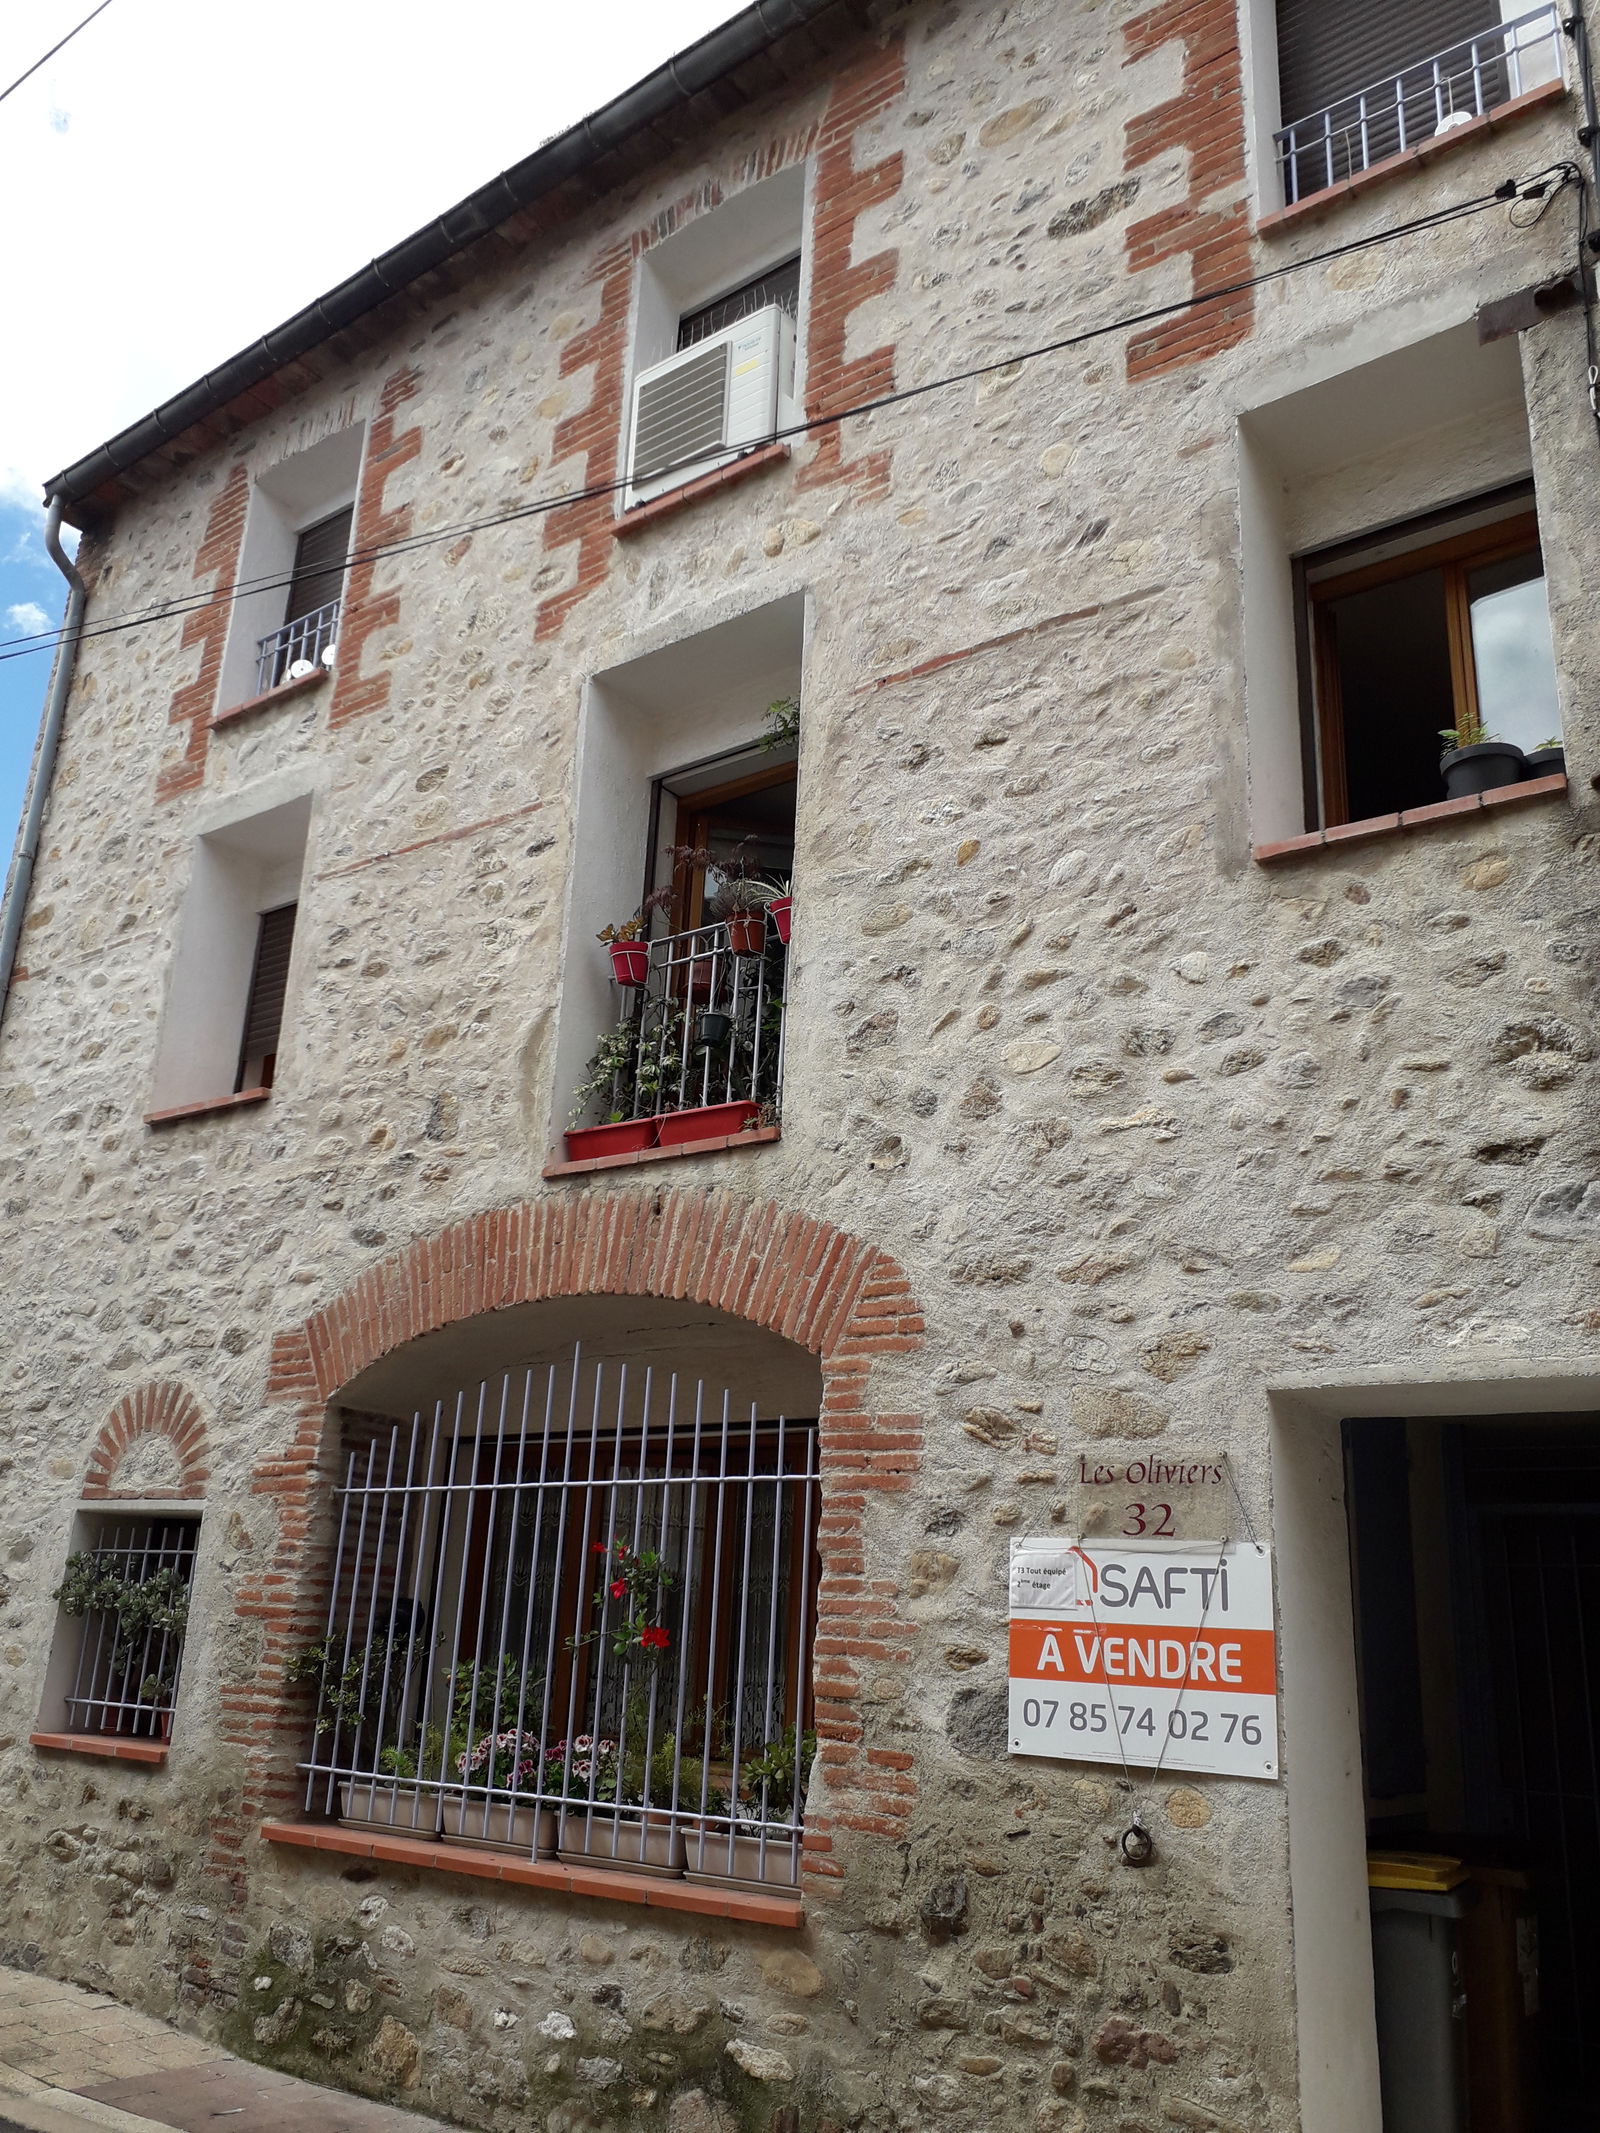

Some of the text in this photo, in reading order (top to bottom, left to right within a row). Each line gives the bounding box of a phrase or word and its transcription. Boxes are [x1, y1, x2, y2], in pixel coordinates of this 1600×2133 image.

[1080, 1454, 1222, 1484] Les Oliviers
[1122, 1503, 1176, 1536] 32
[1026, 1567, 1042, 1575] Tout
[1043, 1567, 1067, 1576] équipé
[1032, 1581, 1051, 1590] étage
[1074, 1635, 1243, 1683] VENDRE
[1023, 1698, 1262, 1745] 07 85 74 02 76
